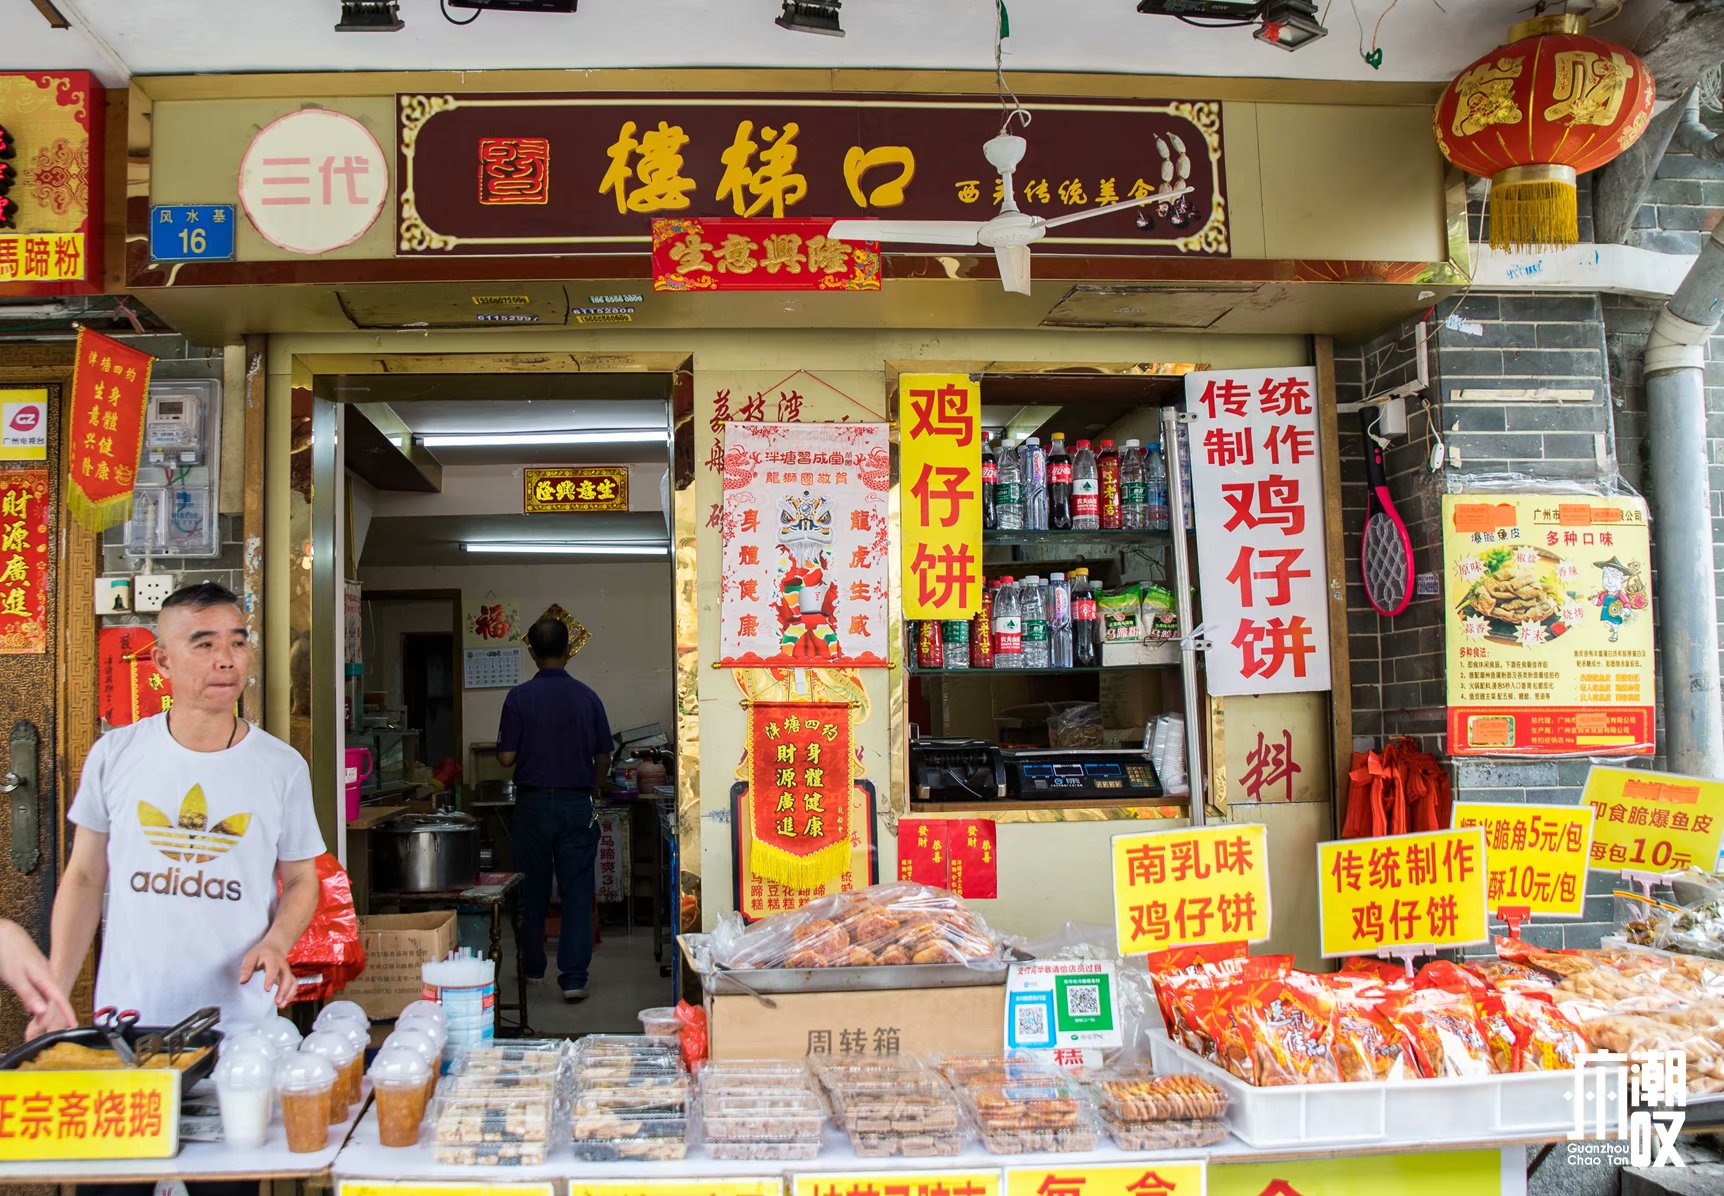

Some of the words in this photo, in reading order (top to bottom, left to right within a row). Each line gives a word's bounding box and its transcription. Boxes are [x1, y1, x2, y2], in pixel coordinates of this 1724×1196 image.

[261, 156, 369, 205] 三代
[599, 120, 915, 218] 樓梯口
[159, 208, 226, 229] 风水基
[178, 228, 207, 255] 16
[0, 237, 80, 279] 馬蹄粉
[1200, 376, 1313, 420] 传统
[1203, 424, 1316, 468] 制作
[909, 383, 976, 609] 鸡仔饼
[1103, 470, 1117, 516] 王老吉
[0, 489, 33, 618] 財源廣進
[1546, 530, 1614, 546] 多种口味
[849, 509, 871, 638] 龍虎生威
[1222, 474, 1317, 680] 鸡仔饼
[1239, 729, 1304, 801] 料
[775, 743, 798, 837] 財源廣進
[130, 867, 242, 901] adidas
[1126, 836, 1253, 887] 南乳味
[1331, 838, 1474, 893] 传统制作
[1129, 891, 1258, 942] 鸡仔饼
[1351, 894, 1459, 943] 鸡仔饼
[806, 1026, 901, 1058] 周转箱
